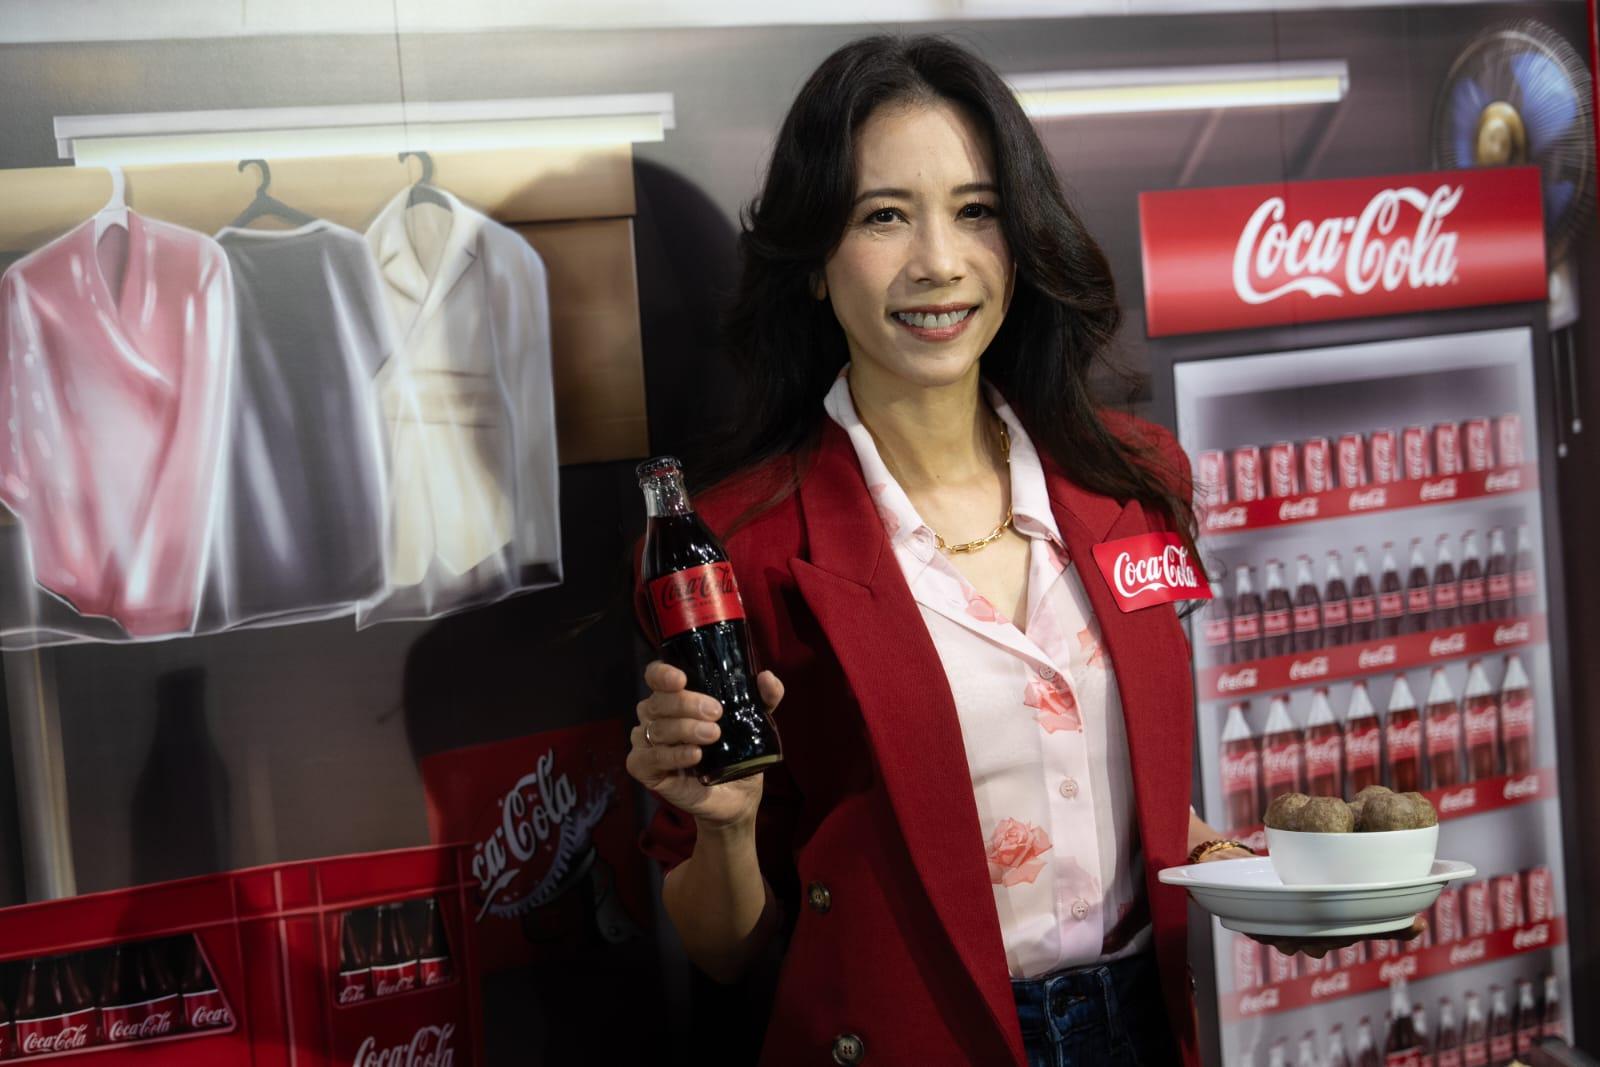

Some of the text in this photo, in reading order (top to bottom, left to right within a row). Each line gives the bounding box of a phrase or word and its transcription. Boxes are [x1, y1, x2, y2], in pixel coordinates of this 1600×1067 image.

[1233, 184, 1464, 304] Coca-Cola
[1113, 544, 1198, 598] Coca-Cola
[23, 1023, 88, 1053] Coca-Cola
